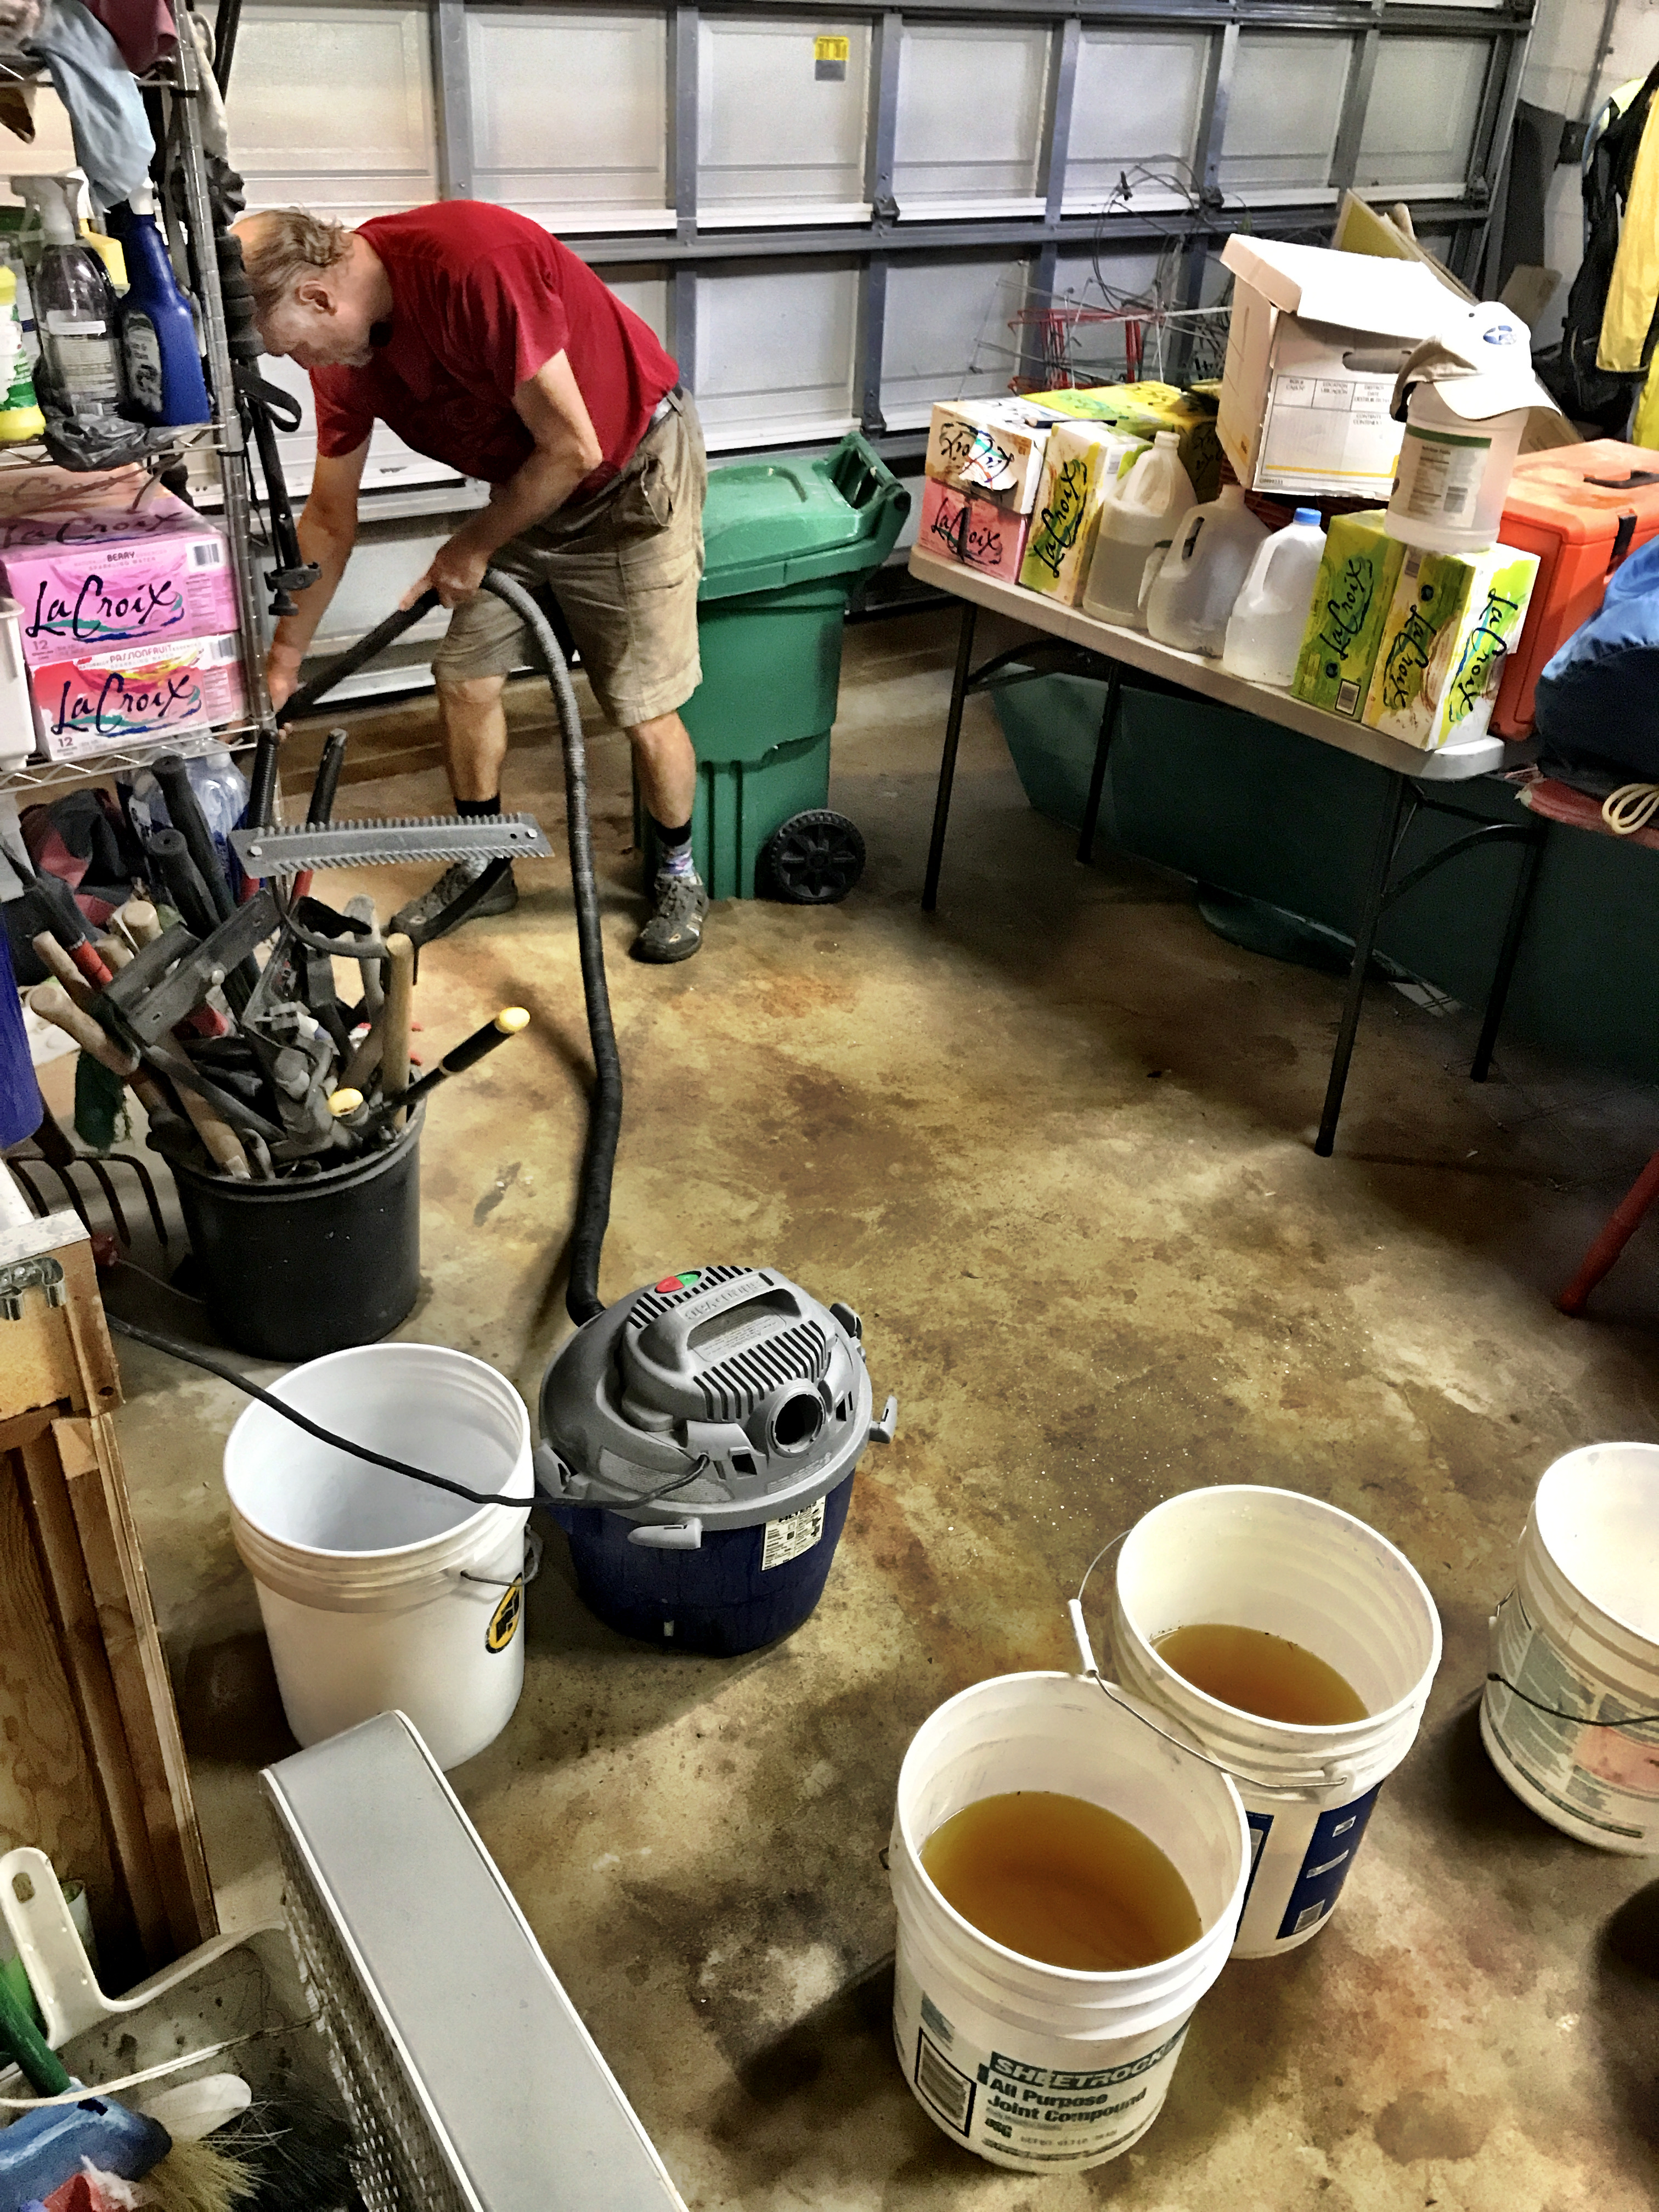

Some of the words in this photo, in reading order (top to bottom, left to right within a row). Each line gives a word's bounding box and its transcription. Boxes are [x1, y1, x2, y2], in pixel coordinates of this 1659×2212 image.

[107, 551, 136, 562] BERRY
[25, 574, 172, 639] LaCroix
[33, 639, 48, 651] 12
[50, 672, 190, 735] LaCroix
[58, 736, 73, 747] 12
[988, 2095, 1041, 2120] Joint
[1045, 2086, 1147, 2123] Compound
[989, 2078, 1017, 2098] All
[1023, 2089, 1108, 2108] Purpose
